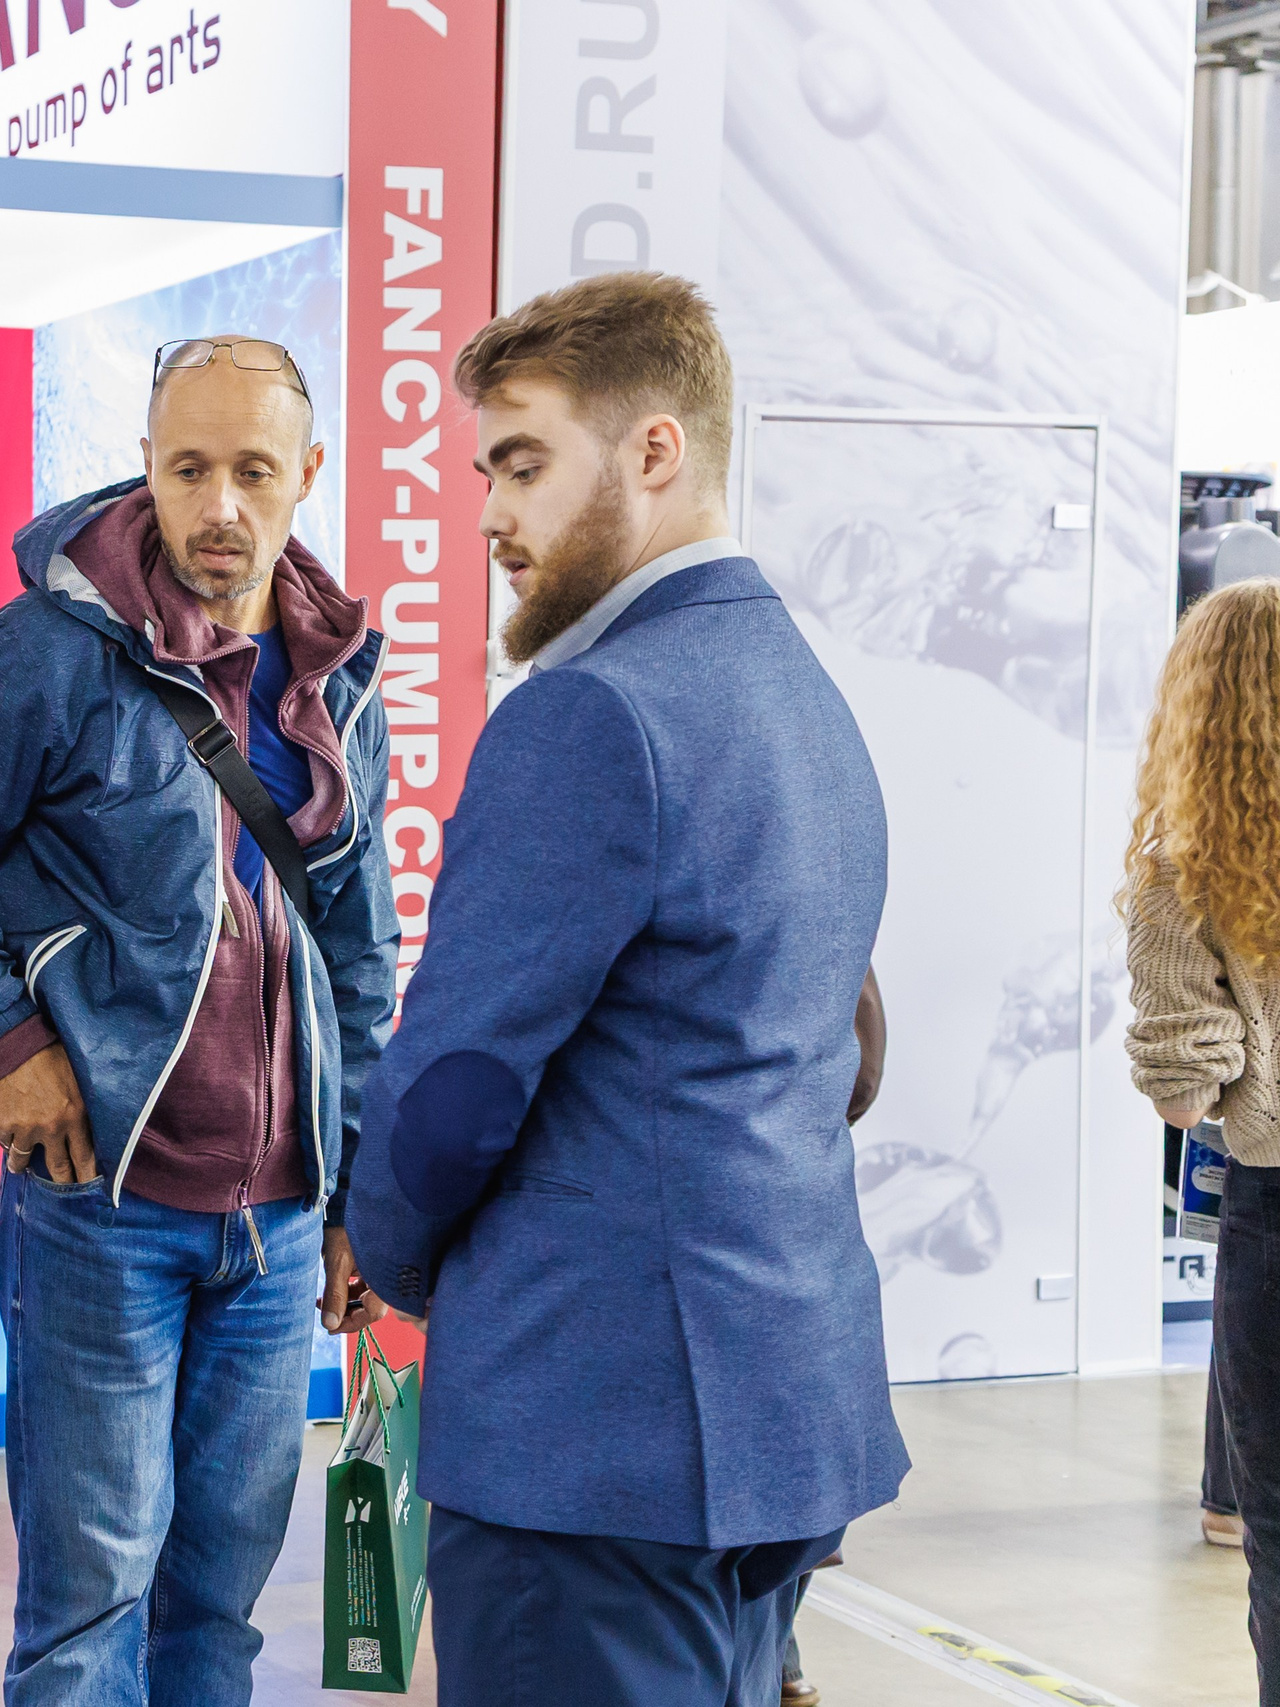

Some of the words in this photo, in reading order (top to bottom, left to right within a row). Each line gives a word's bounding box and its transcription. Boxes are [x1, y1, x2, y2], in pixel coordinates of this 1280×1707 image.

[8, 83, 87, 157] pump
[101, 40, 133, 115] of
[145, 8, 221, 95] arts
